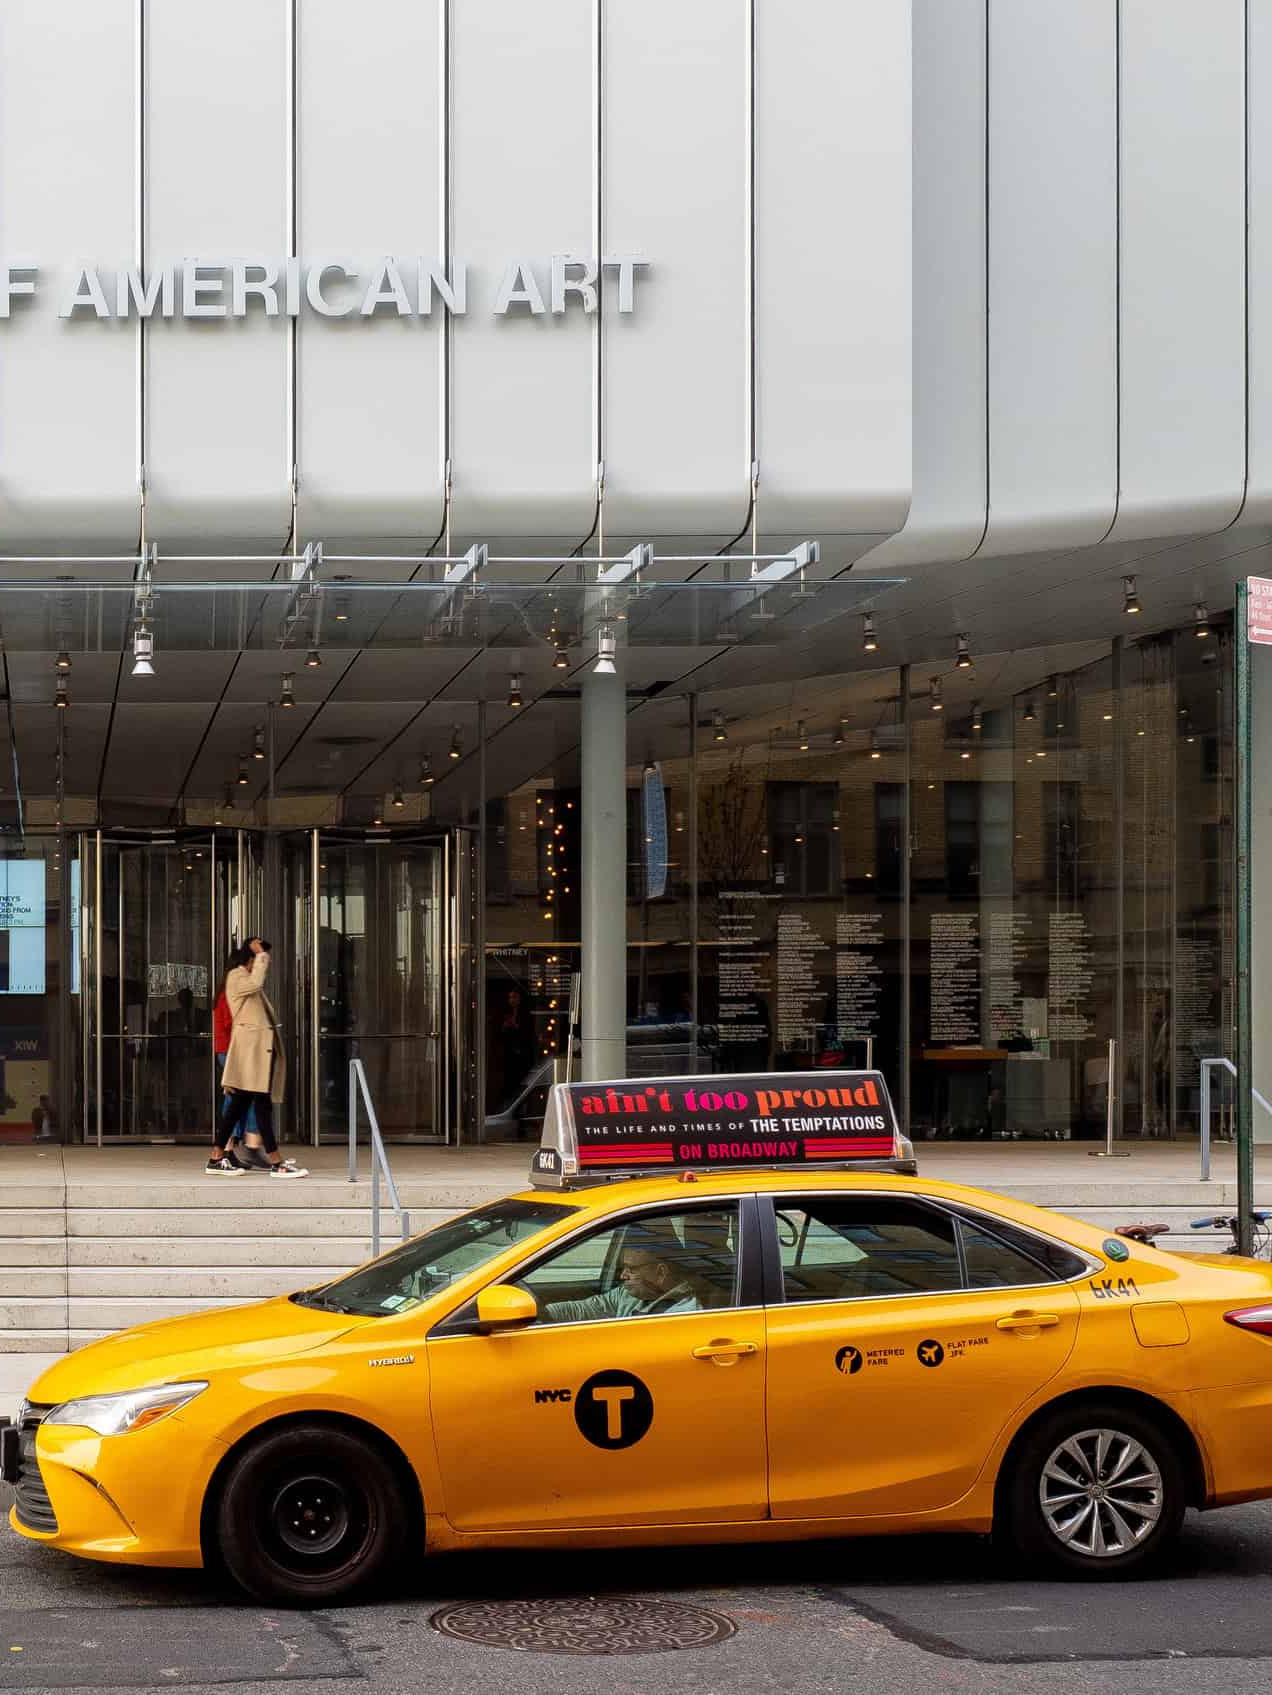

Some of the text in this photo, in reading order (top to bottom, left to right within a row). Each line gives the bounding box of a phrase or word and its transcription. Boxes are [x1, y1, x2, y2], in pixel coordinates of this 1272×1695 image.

[58, 257, 468, 319] AMERICAN
[494, 254, 650, 315] ART
[581, 1081, 881, 1117] ain't too proud
[585, 1115, 886, 1135] THE LIFE AND TIMES OF THE TEMPTATIONS
[678, 1140, 798, 1160] ON BROADWAY
[866, 1349, 904, 1357] METERED
[947, 1337, 988, 1349] FLAT FARE
[867, 1358, 888, 1366] FARE
[534, 1385, 634, 1440] NYC T
